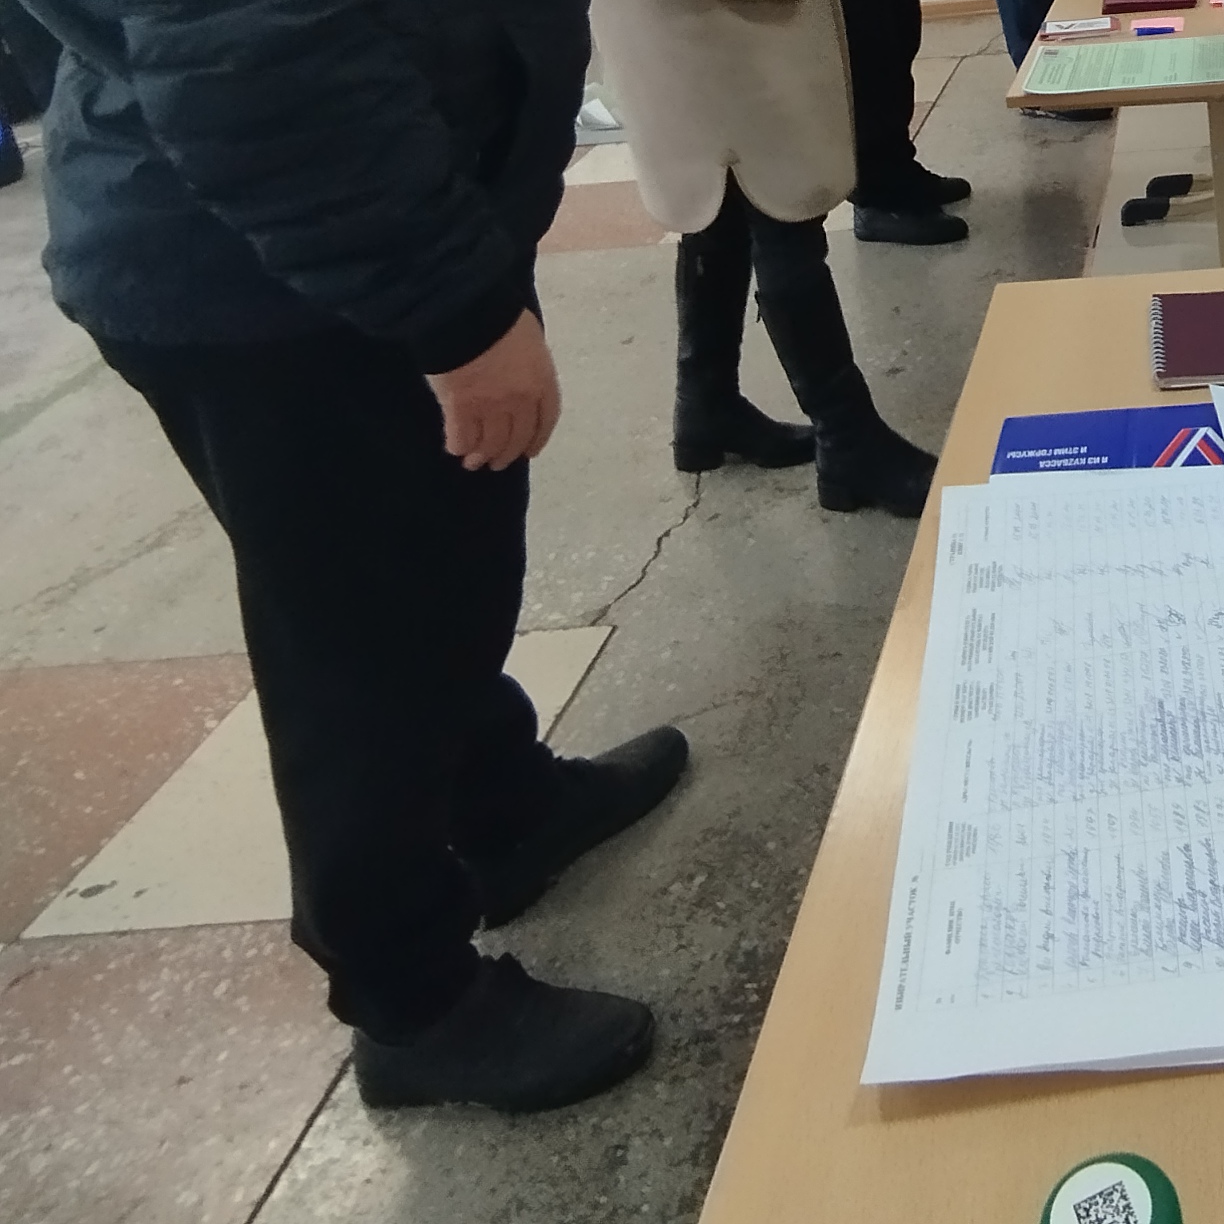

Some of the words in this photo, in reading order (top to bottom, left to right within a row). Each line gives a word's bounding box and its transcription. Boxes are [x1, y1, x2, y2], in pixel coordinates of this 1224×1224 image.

[1053, 446, 1080, 457] ЭТИМ
[1087, 456, 1101, 465] ИЗ
[894, 932, 912, 1011] ИЗБИРАТЕЛЬНЫЙ
[905, 887, 918, 930] УЧАСТОК
